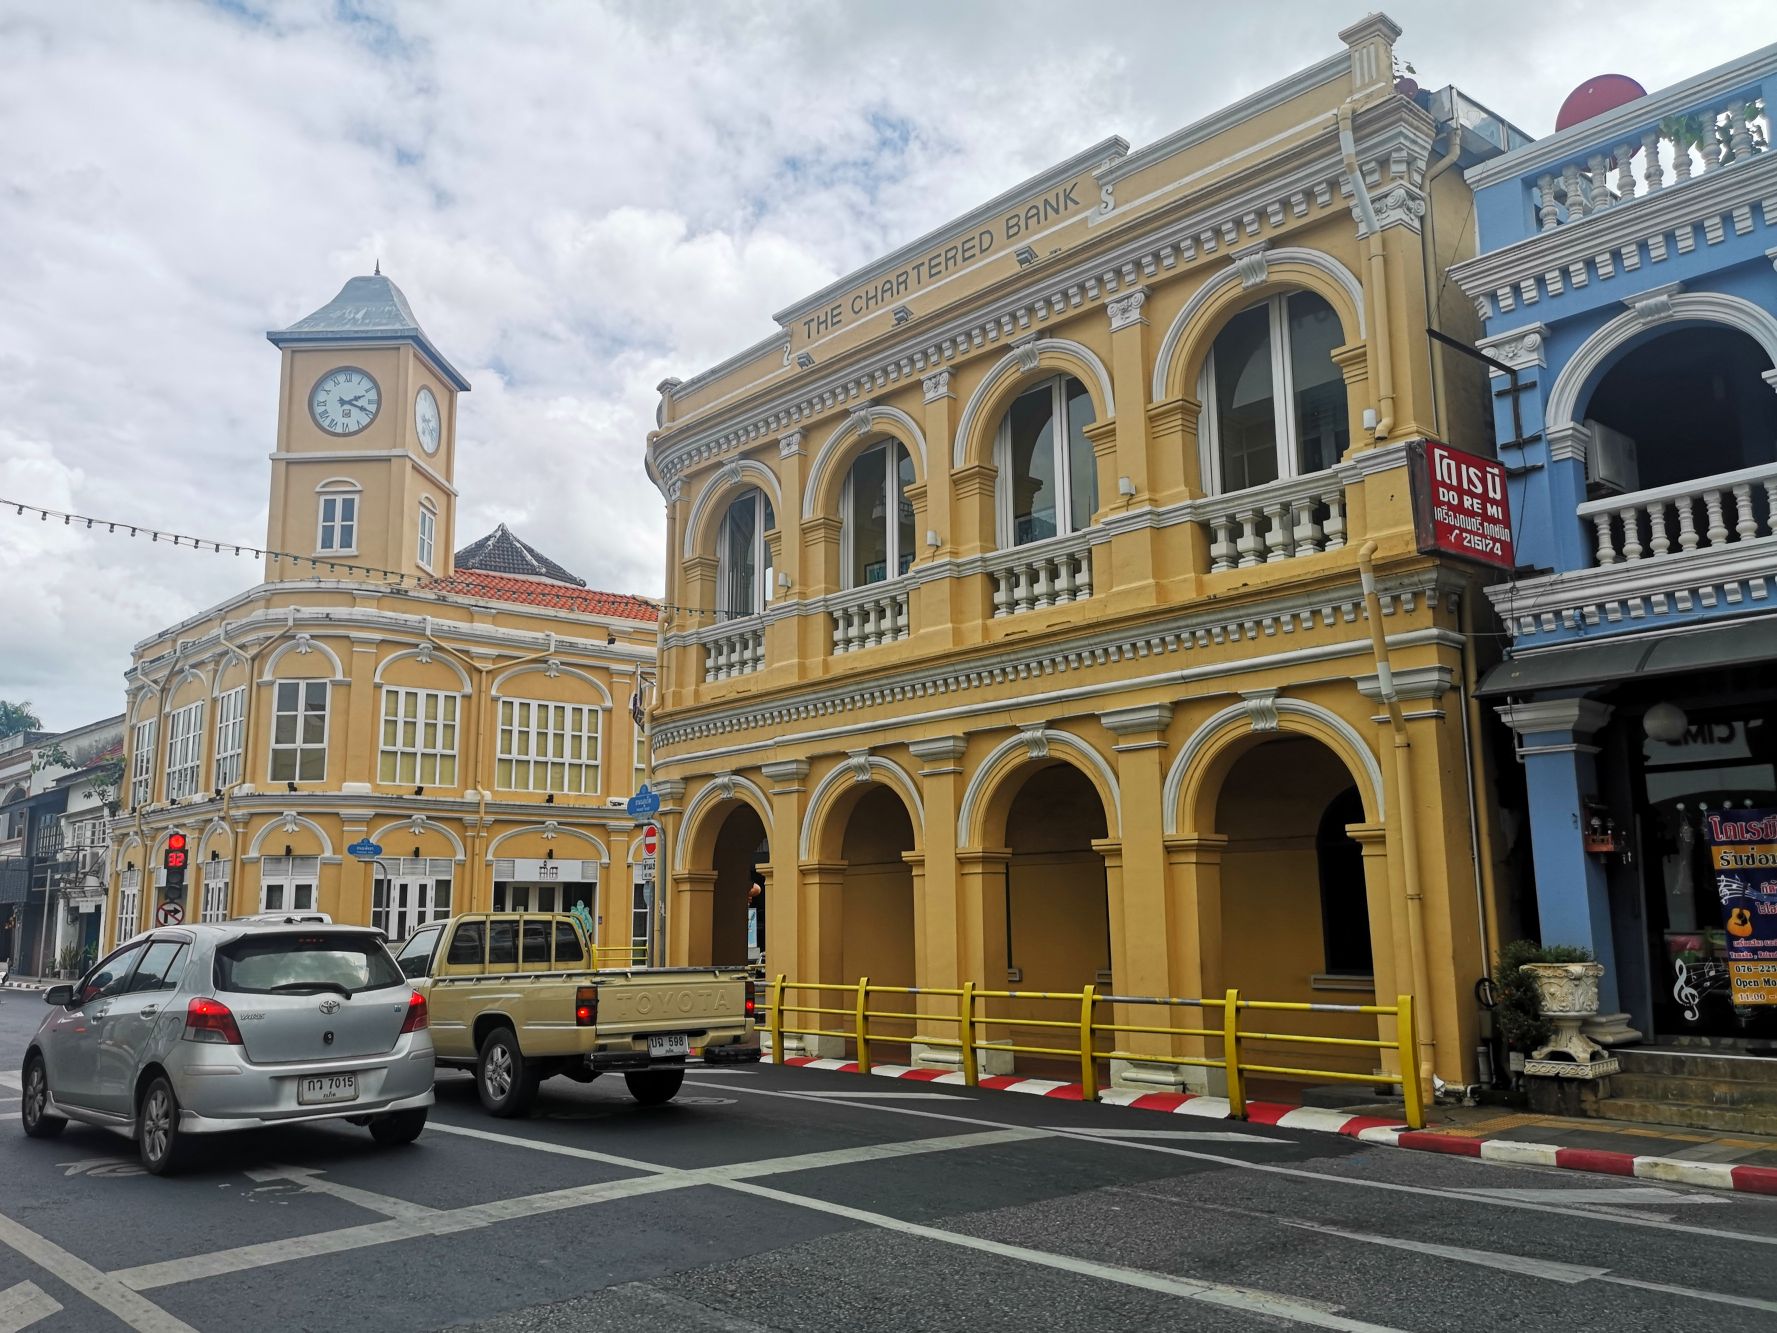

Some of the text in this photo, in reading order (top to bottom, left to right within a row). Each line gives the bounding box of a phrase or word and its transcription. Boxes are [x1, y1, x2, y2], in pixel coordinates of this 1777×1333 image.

[803, 182, 1081, 339] THE CHARTERED BANK
[1438, 487, 1503, 520] DO RE MI
[1462, 532, 1502, 556] 215174
[1735, 978, 1760, 988] Open
[616, 989, 731, 1016] TOYOTA
[1739, 992, 1766, 1001] 11.00
[668, 1036, 684, 1047] 598
[308, 1076, 354, 1091] กว 7015
